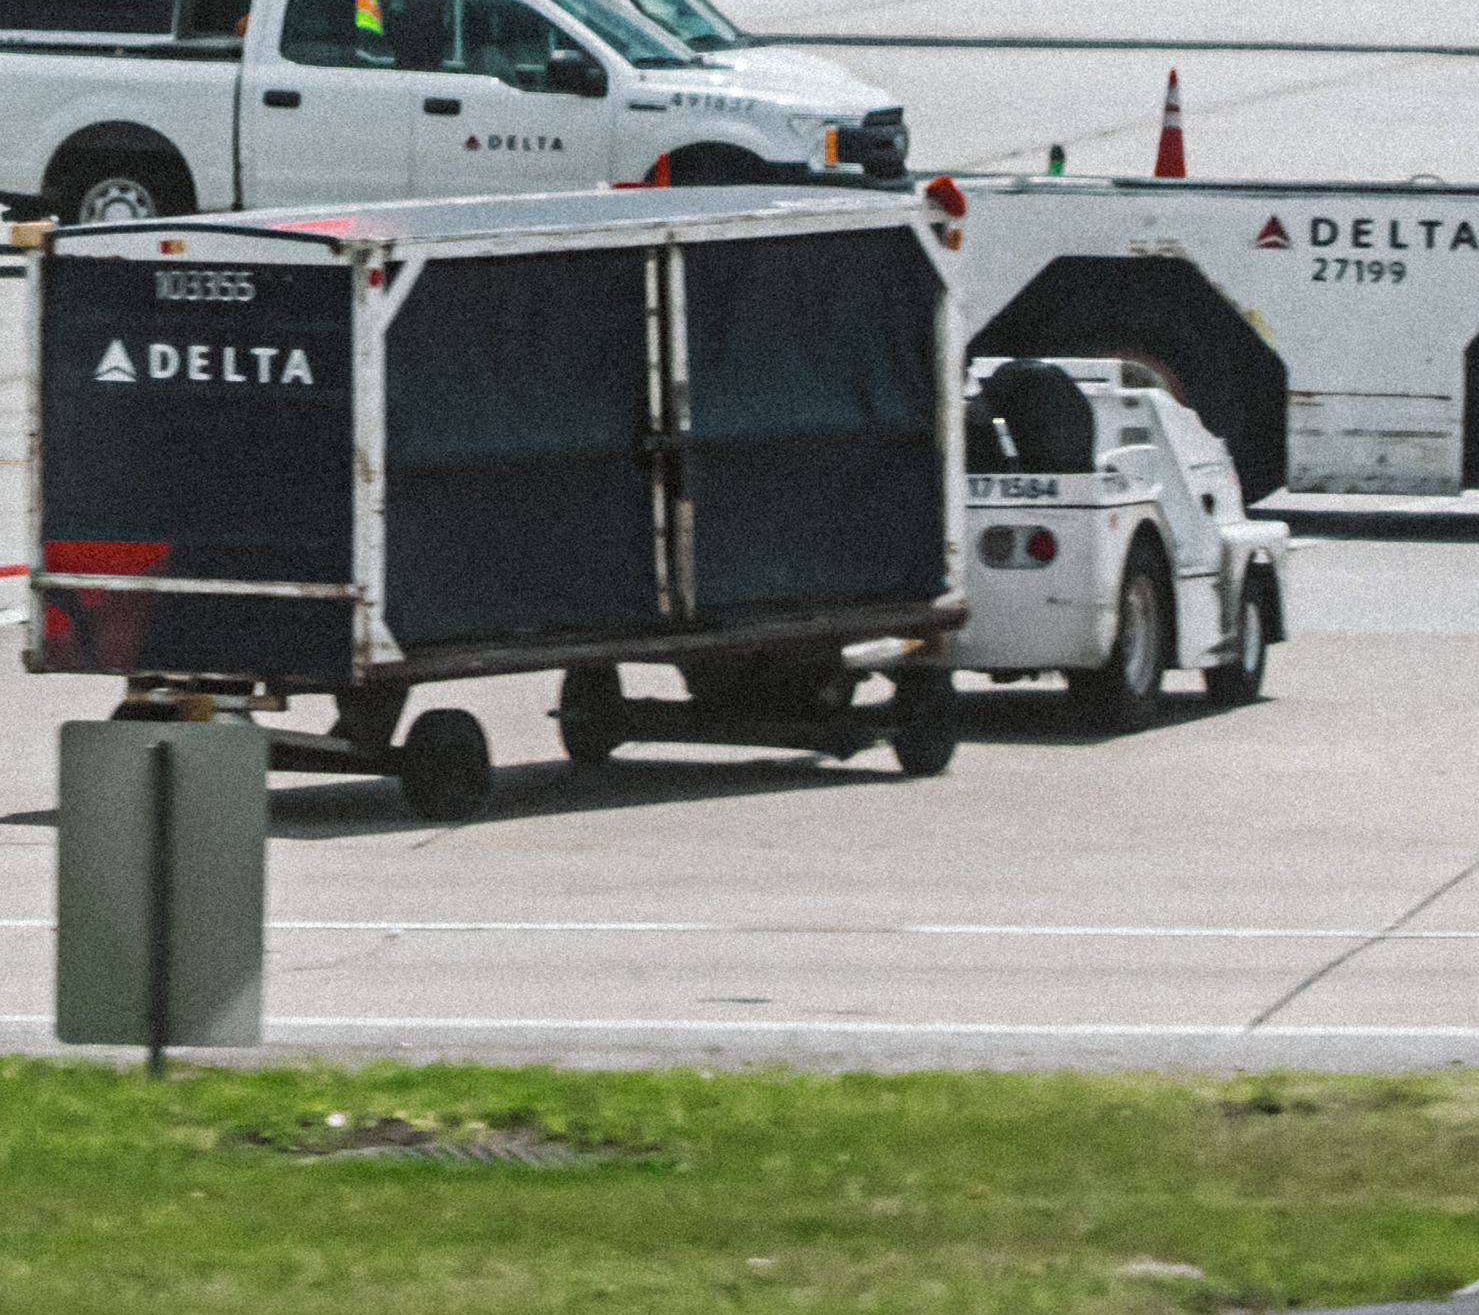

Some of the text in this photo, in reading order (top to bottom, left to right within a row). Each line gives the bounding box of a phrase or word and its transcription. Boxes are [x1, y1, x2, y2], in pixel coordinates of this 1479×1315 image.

[487, 134, 563, 151] DELTA
[1311, 257, 1407, 284] 27199
[148, 342, 315, 386] DELTA
